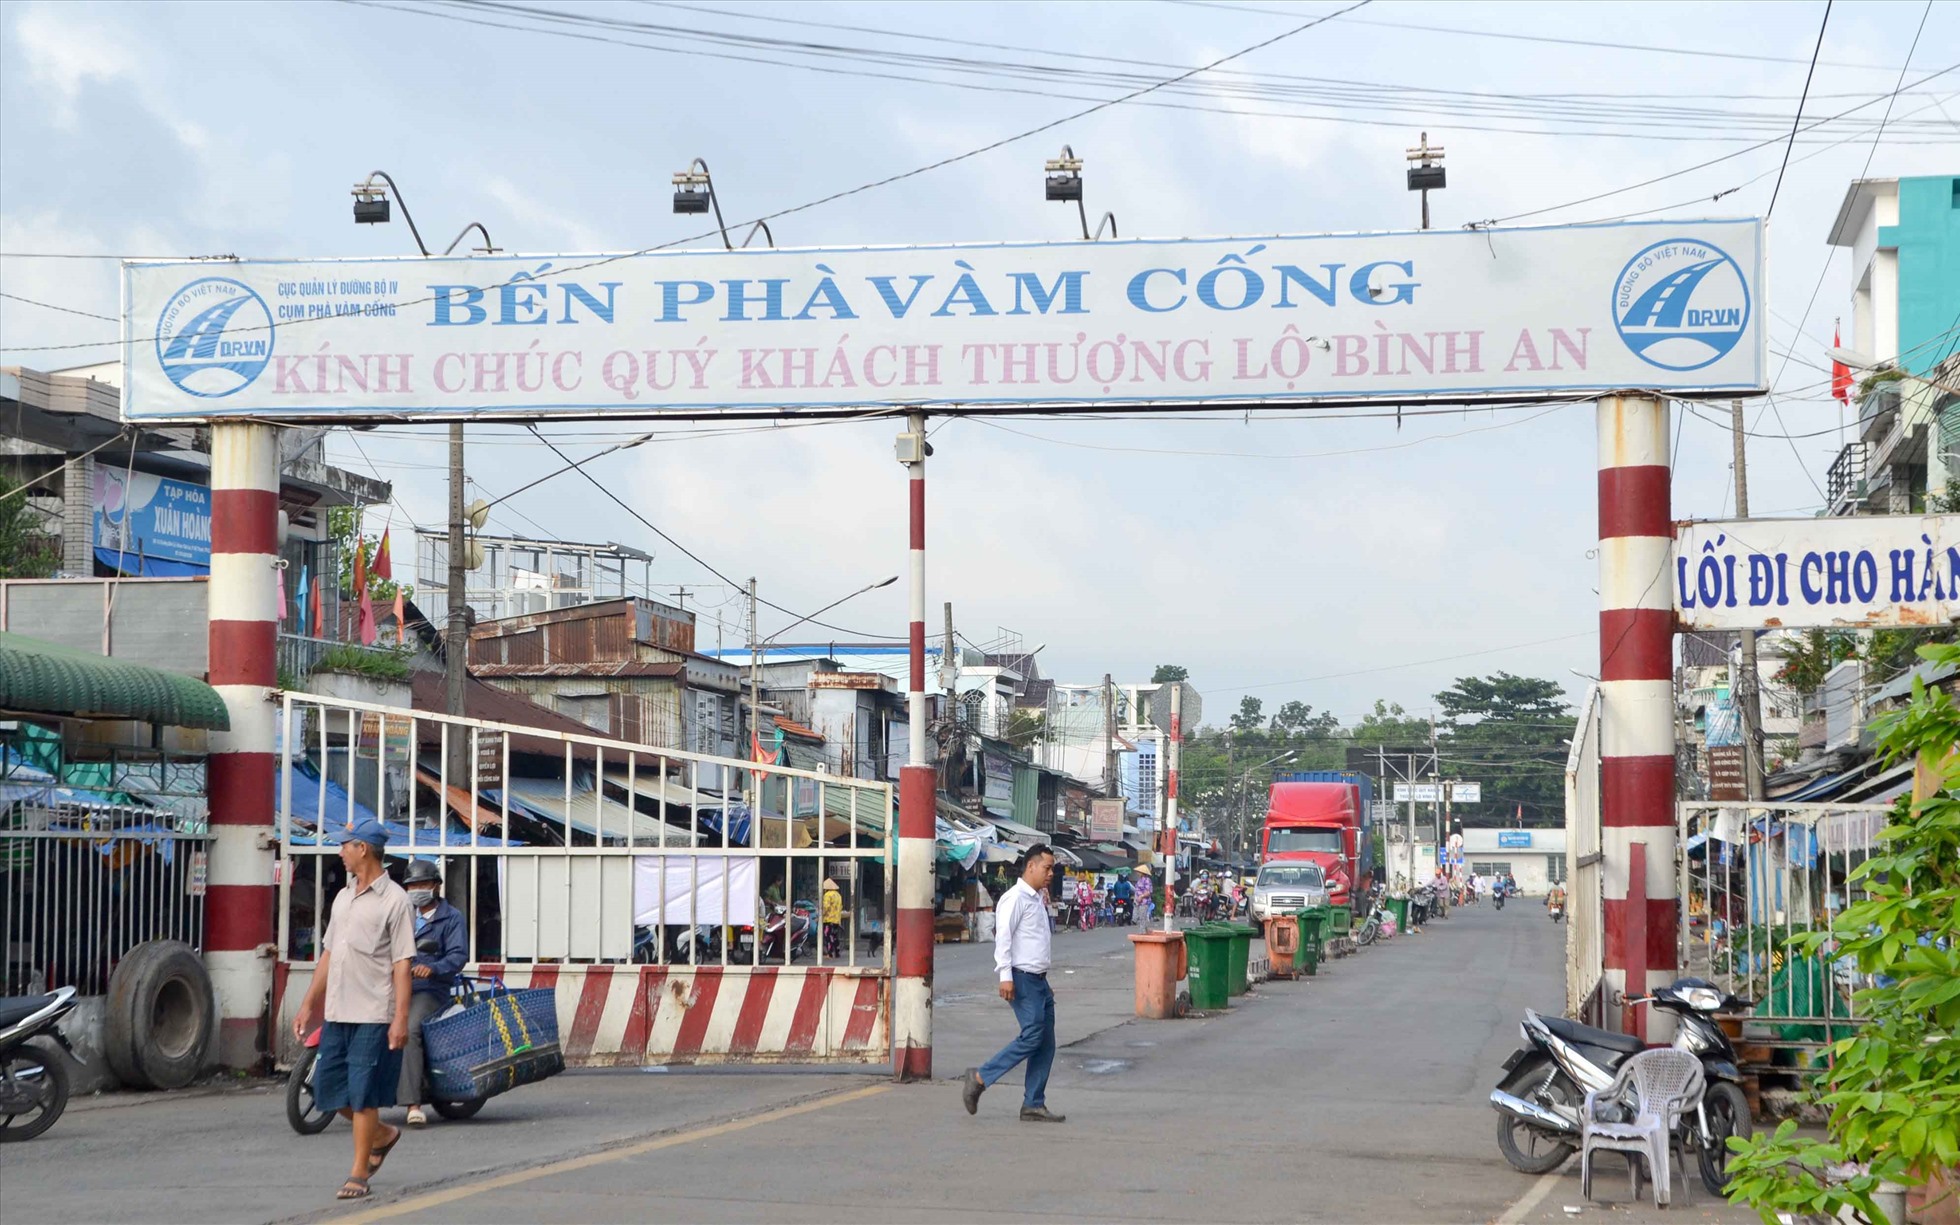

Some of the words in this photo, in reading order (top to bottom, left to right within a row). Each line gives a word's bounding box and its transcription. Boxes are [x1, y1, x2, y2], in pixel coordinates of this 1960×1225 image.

[1682, 247, 1706, 260] NAM
[215, 285, 237, 296] NAM
[278, 282, 297, 299] CỤC
[299, 277, 325, 297] QUẢN
[340, 279, 371, 295] ĐƯỜNG
[374, 278, 387, 297] BỘ
[389, 281, 398, 294] IV
[426, 262, 622, 326] BẾN
[654, 263, 859, 322] PHÀ
[865, 259, 1090, 318] VÀM
[1126, 244, 1422, 313] CỐNG
[278, 304, 305, 321] CỤM
[308, 300, 332, 318] PHÀ
[335, 300, 361, 317] VÀM
[364, 298, 396, 317] CỐNG
[1687, 308, 1740, 327] DRVN
[271, 341, 414, 394] KÍNH
[432, 338, 583, 394] CHÚC
[602, 336, 719, 400] QUÝ
[737, 333, 943, 390] KHÁCH
[961, 331, 1215, 394] THƯỢNG
[1232, 324, 1311, 391] LỘ
[1331, 320, 1485, 377] BÌNH
[1503, 328, 1592, 372] AN
[163, 485, 183, 502] TẠP
[185, 489, 205, 505] HÓA
[1677, 533, 1738, 609] LỐI
[1749, 553, 1789, 606] ĐI
[1800, 549, 1878, 605] CHO
